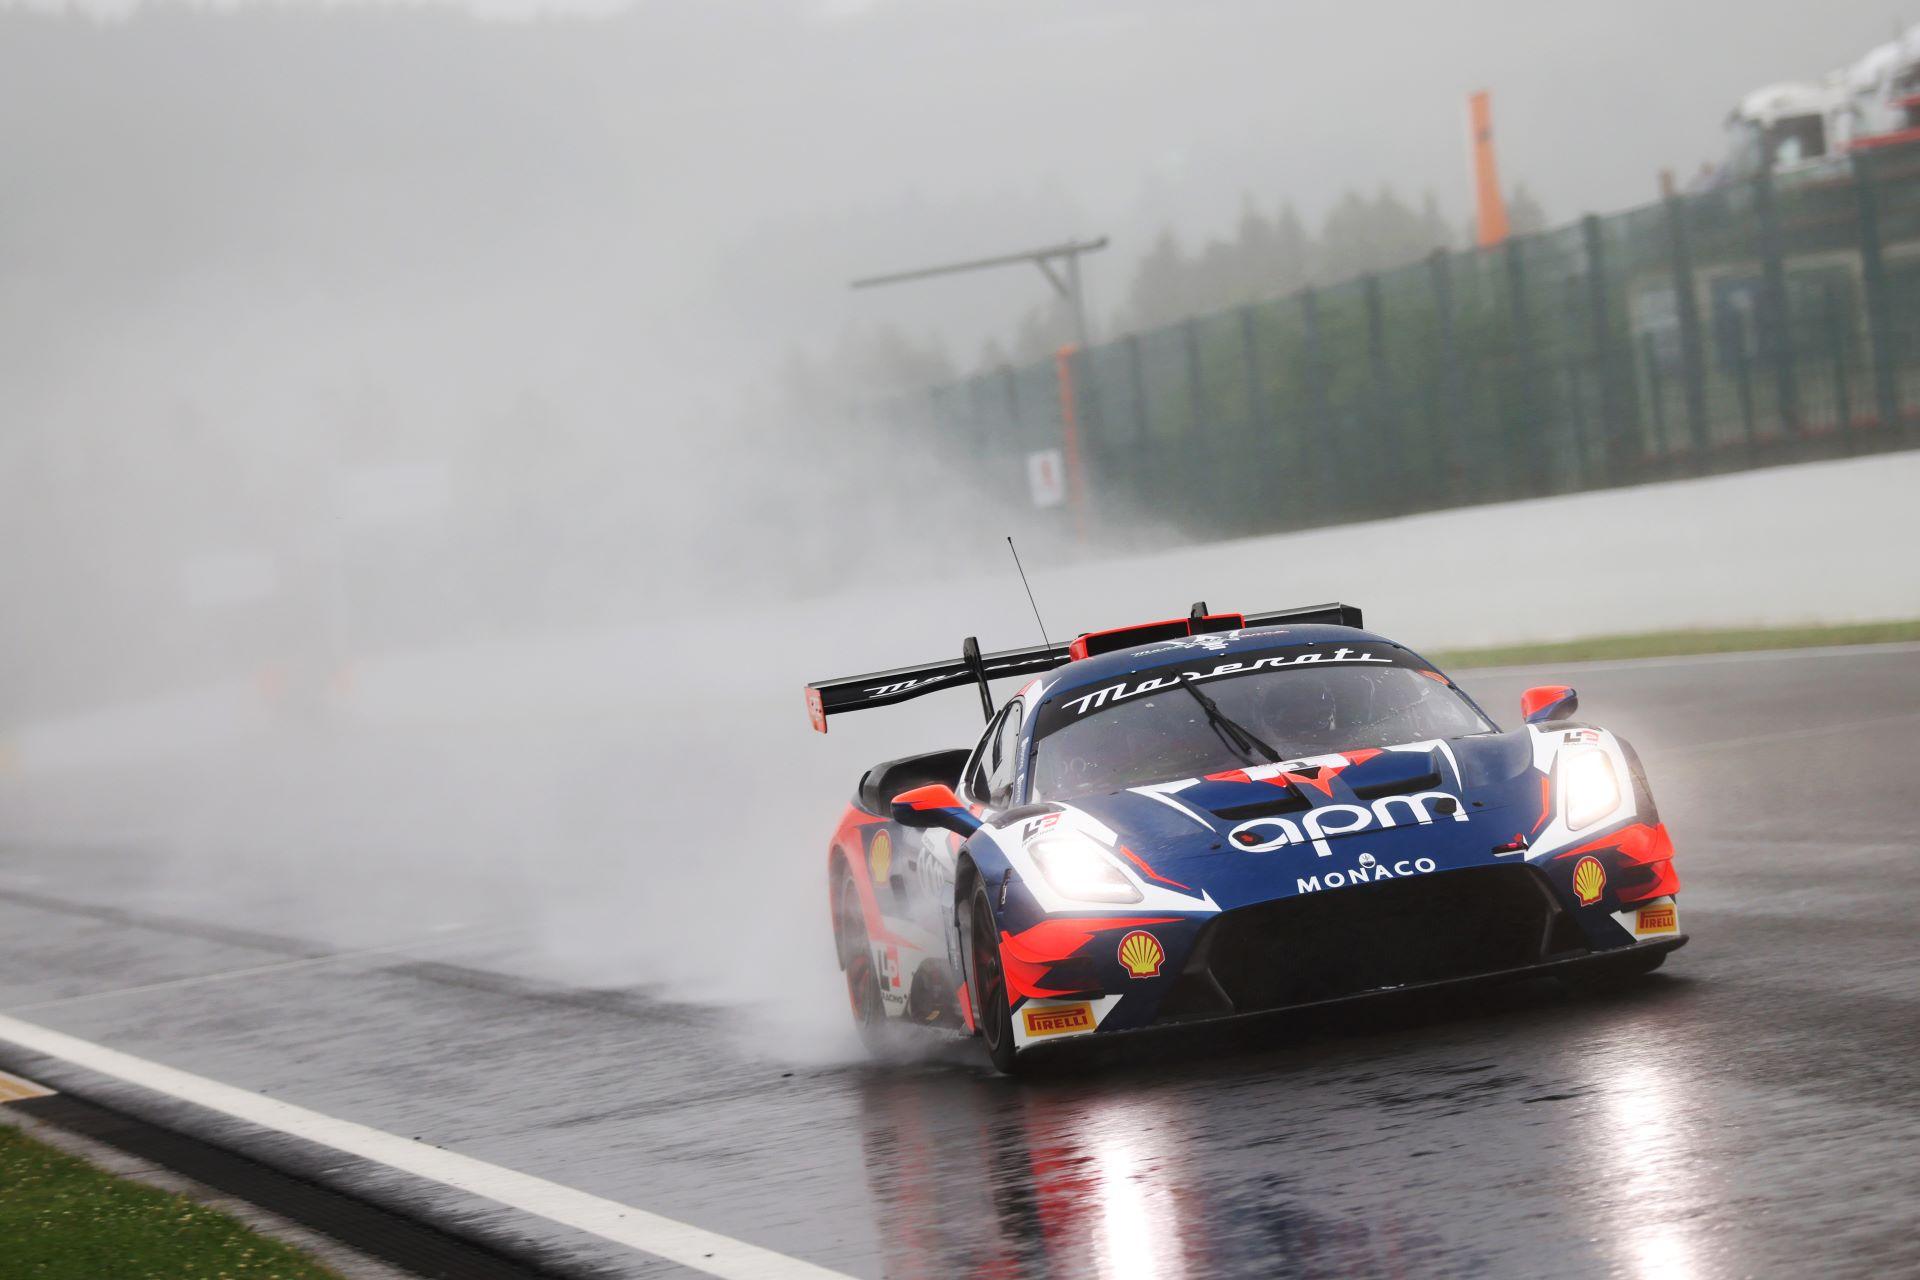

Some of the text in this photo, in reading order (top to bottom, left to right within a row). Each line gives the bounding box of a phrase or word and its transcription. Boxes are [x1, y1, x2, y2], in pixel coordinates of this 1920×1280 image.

[1062, 648, 1392, 714] Maserati
[1228, 791, 1469, 857] apm
[1297, 858, 1436, 893] MONACO
[1640, 910, 1674, 930] PIRELLI
[1027, 1008, 1088, 1031] PIRELLI
